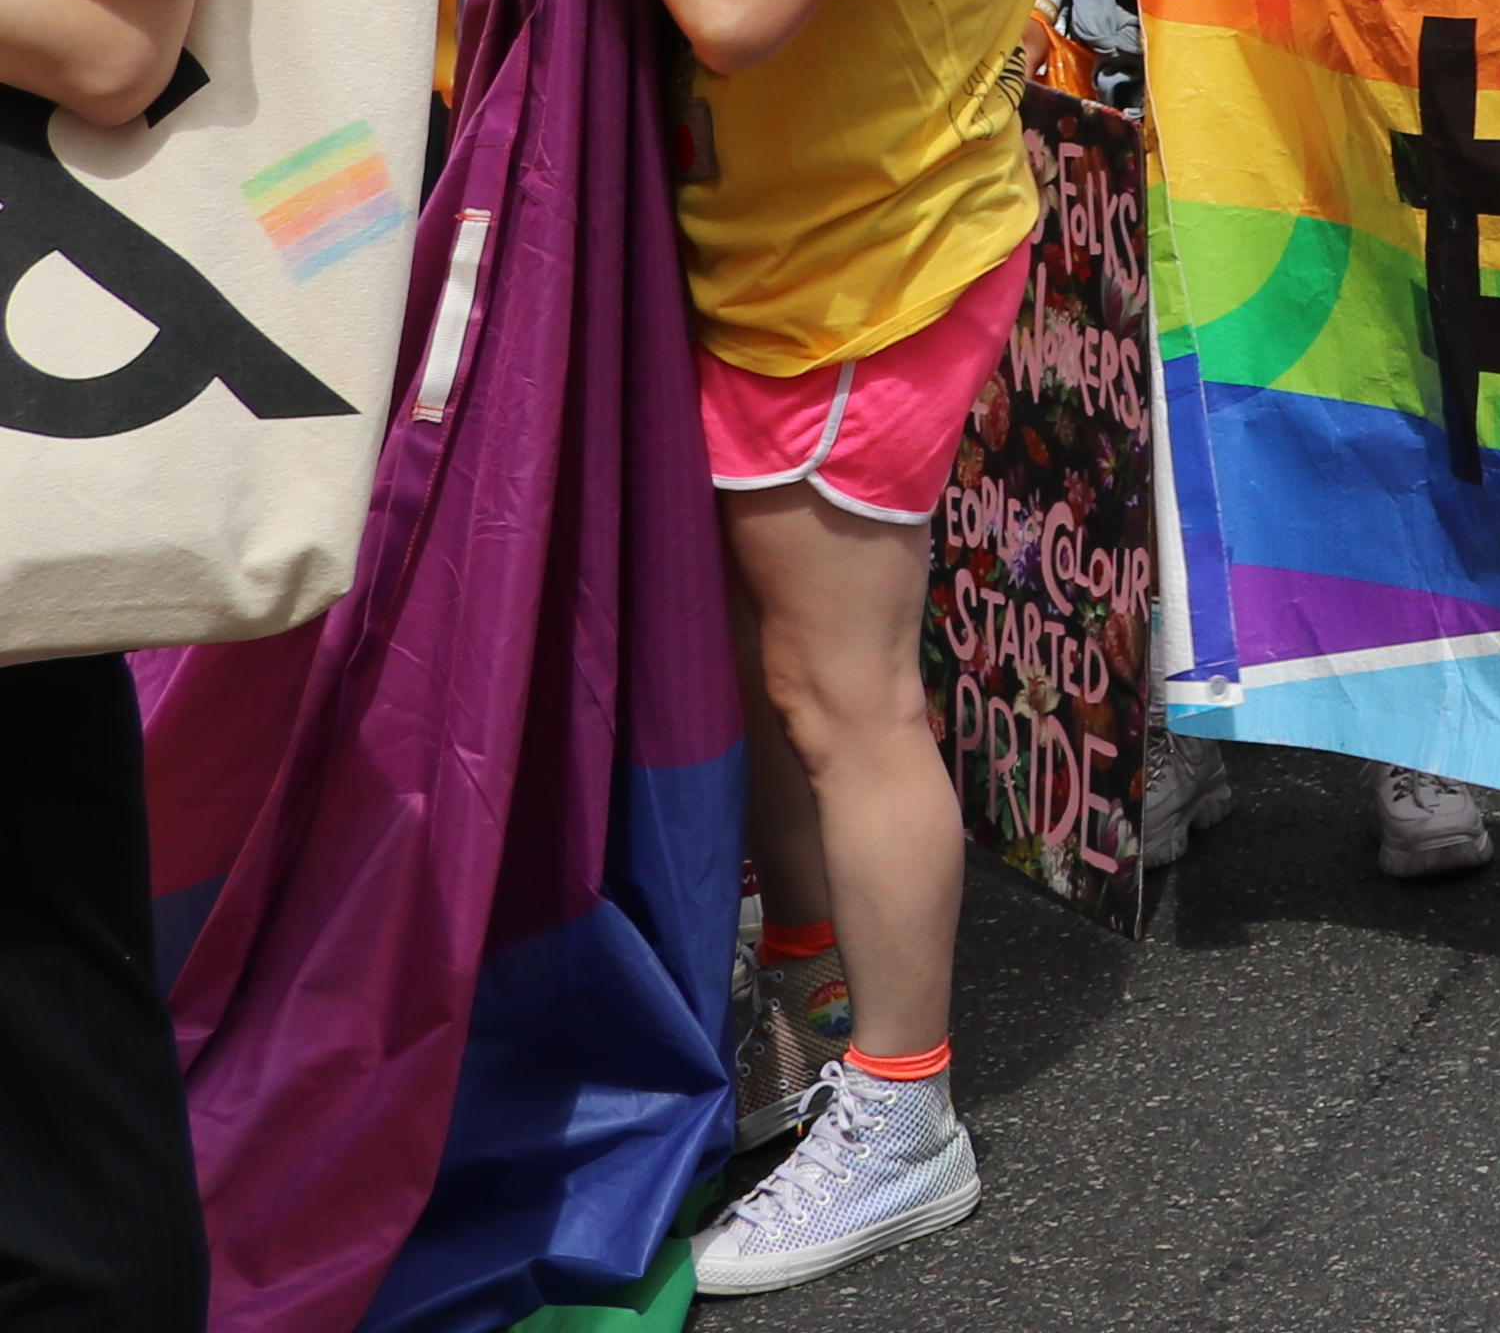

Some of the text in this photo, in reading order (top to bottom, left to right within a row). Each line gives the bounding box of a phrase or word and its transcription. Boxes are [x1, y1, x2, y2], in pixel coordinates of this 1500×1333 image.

[1041, 500, 1150, 619] COLOUR
[945, 568, 1110, 704] STARTED
[956, 674, 1119, 874] PRIDE
